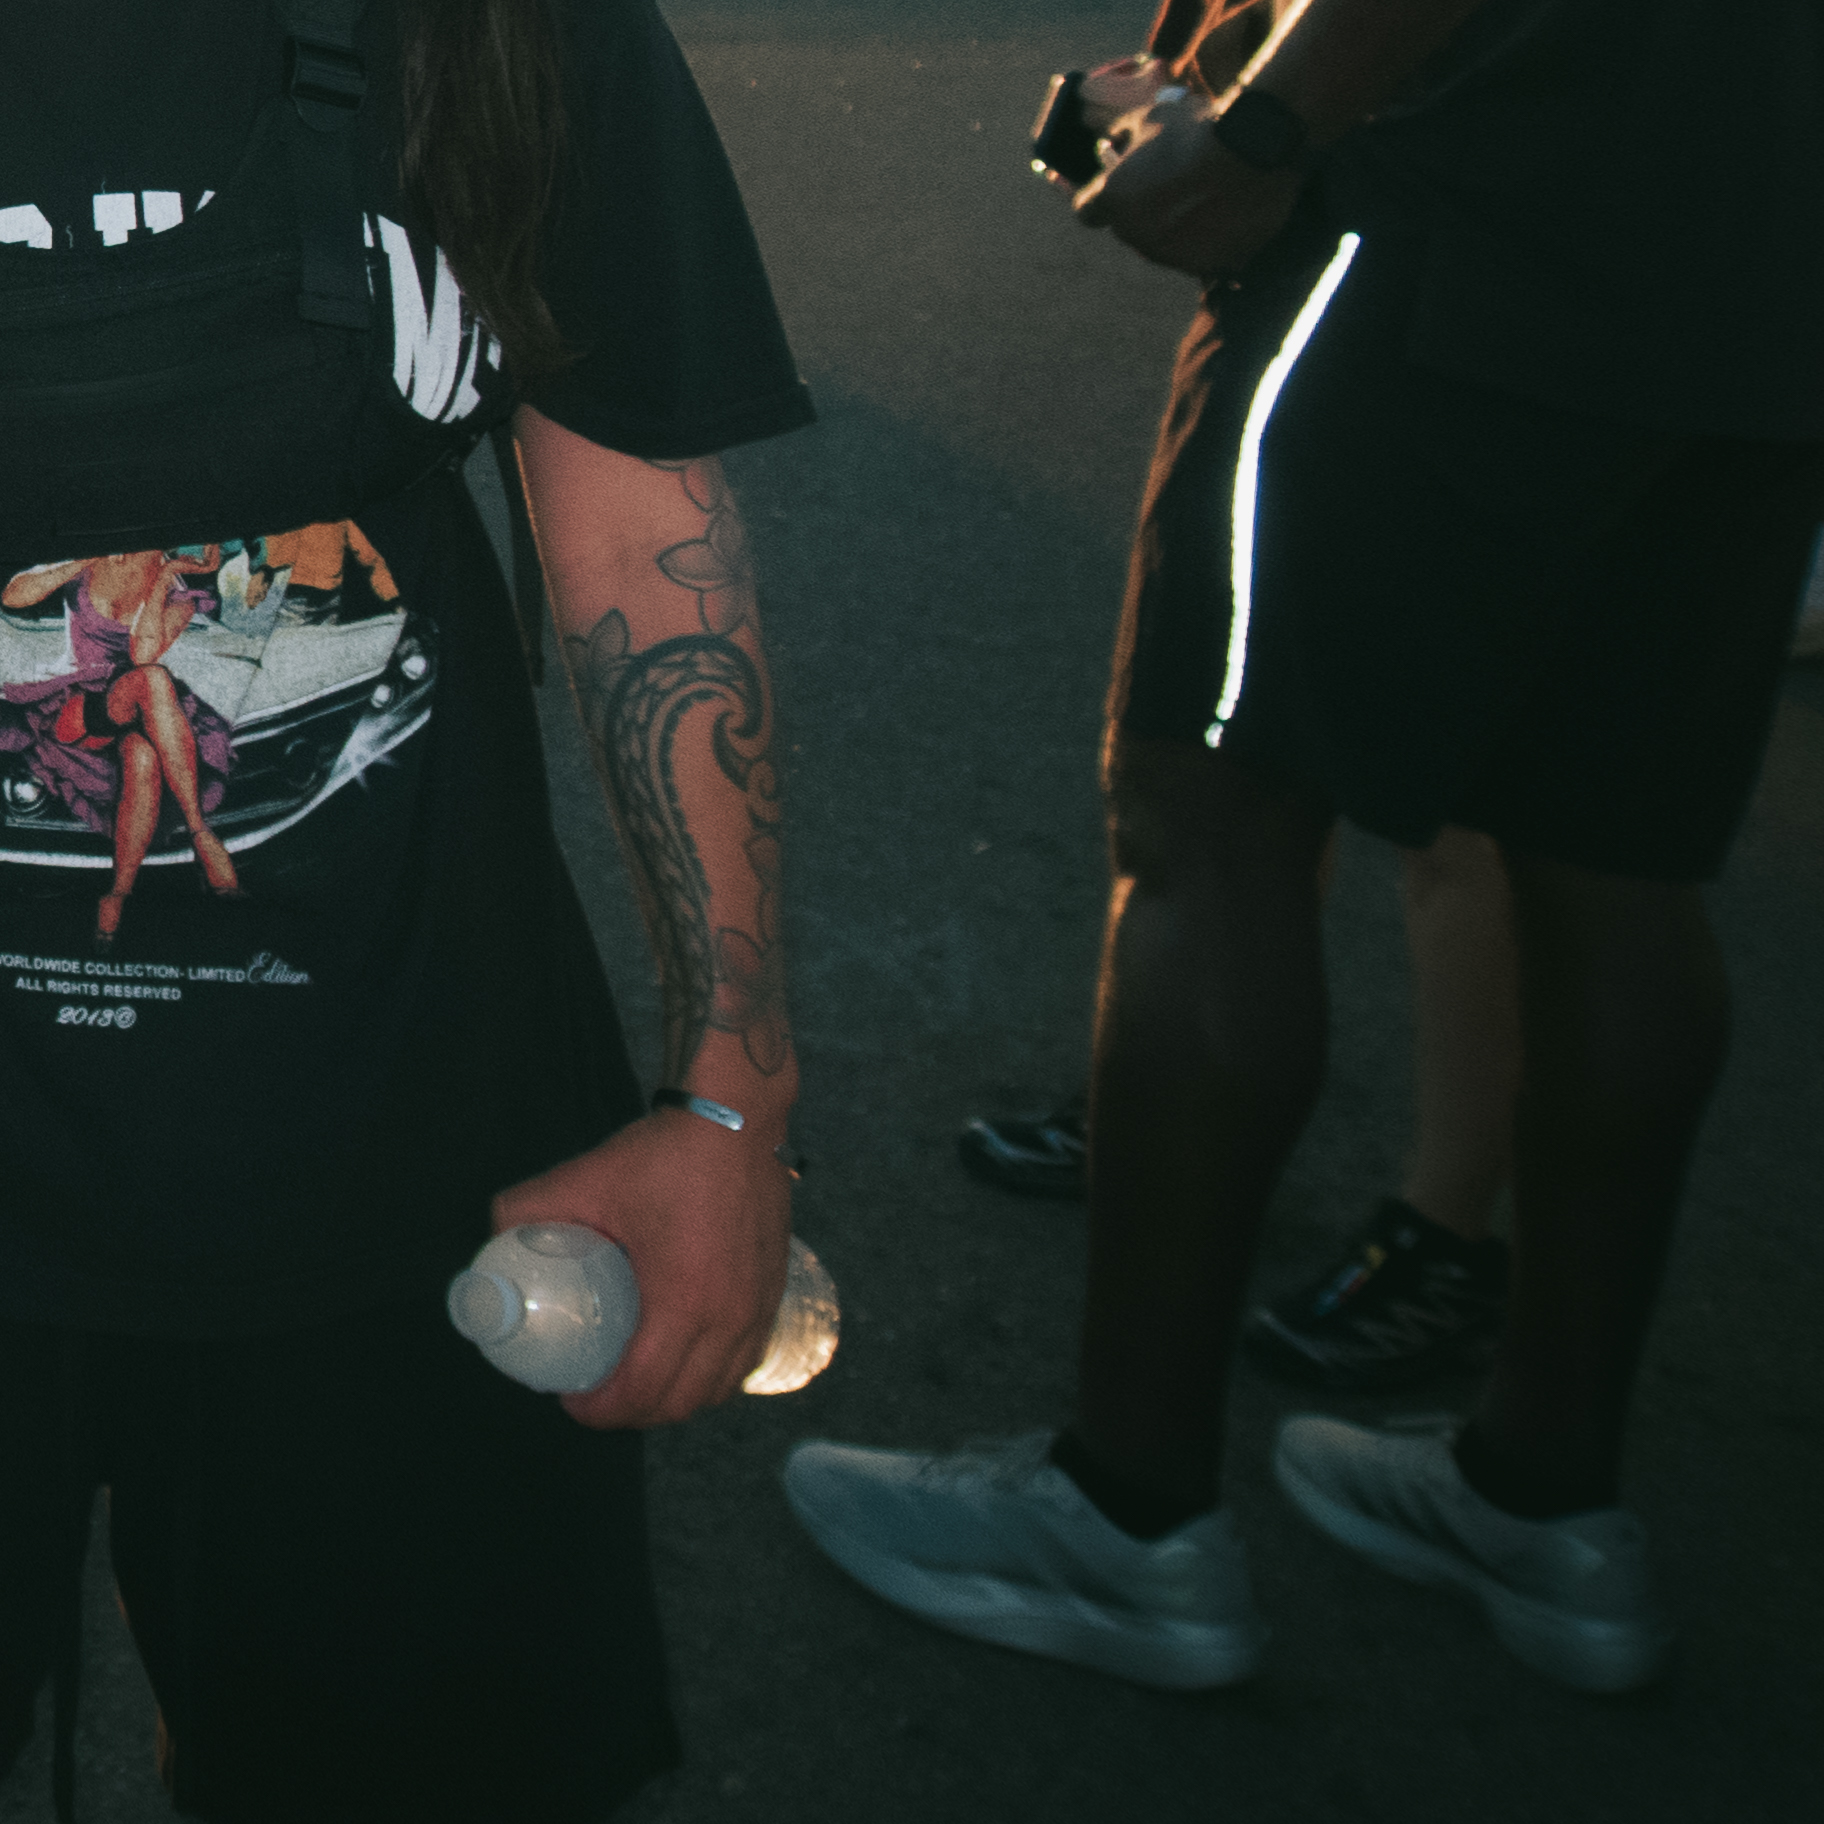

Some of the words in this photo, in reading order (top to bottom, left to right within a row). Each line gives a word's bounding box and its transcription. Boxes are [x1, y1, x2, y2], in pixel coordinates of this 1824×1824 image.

[188, 966, 246, 983] LIMITED
[15, 976, 44, 992] ALL
[47, 979, 100, 996] RIGHTS
[103, 983, 183, 1001] RESERVED
